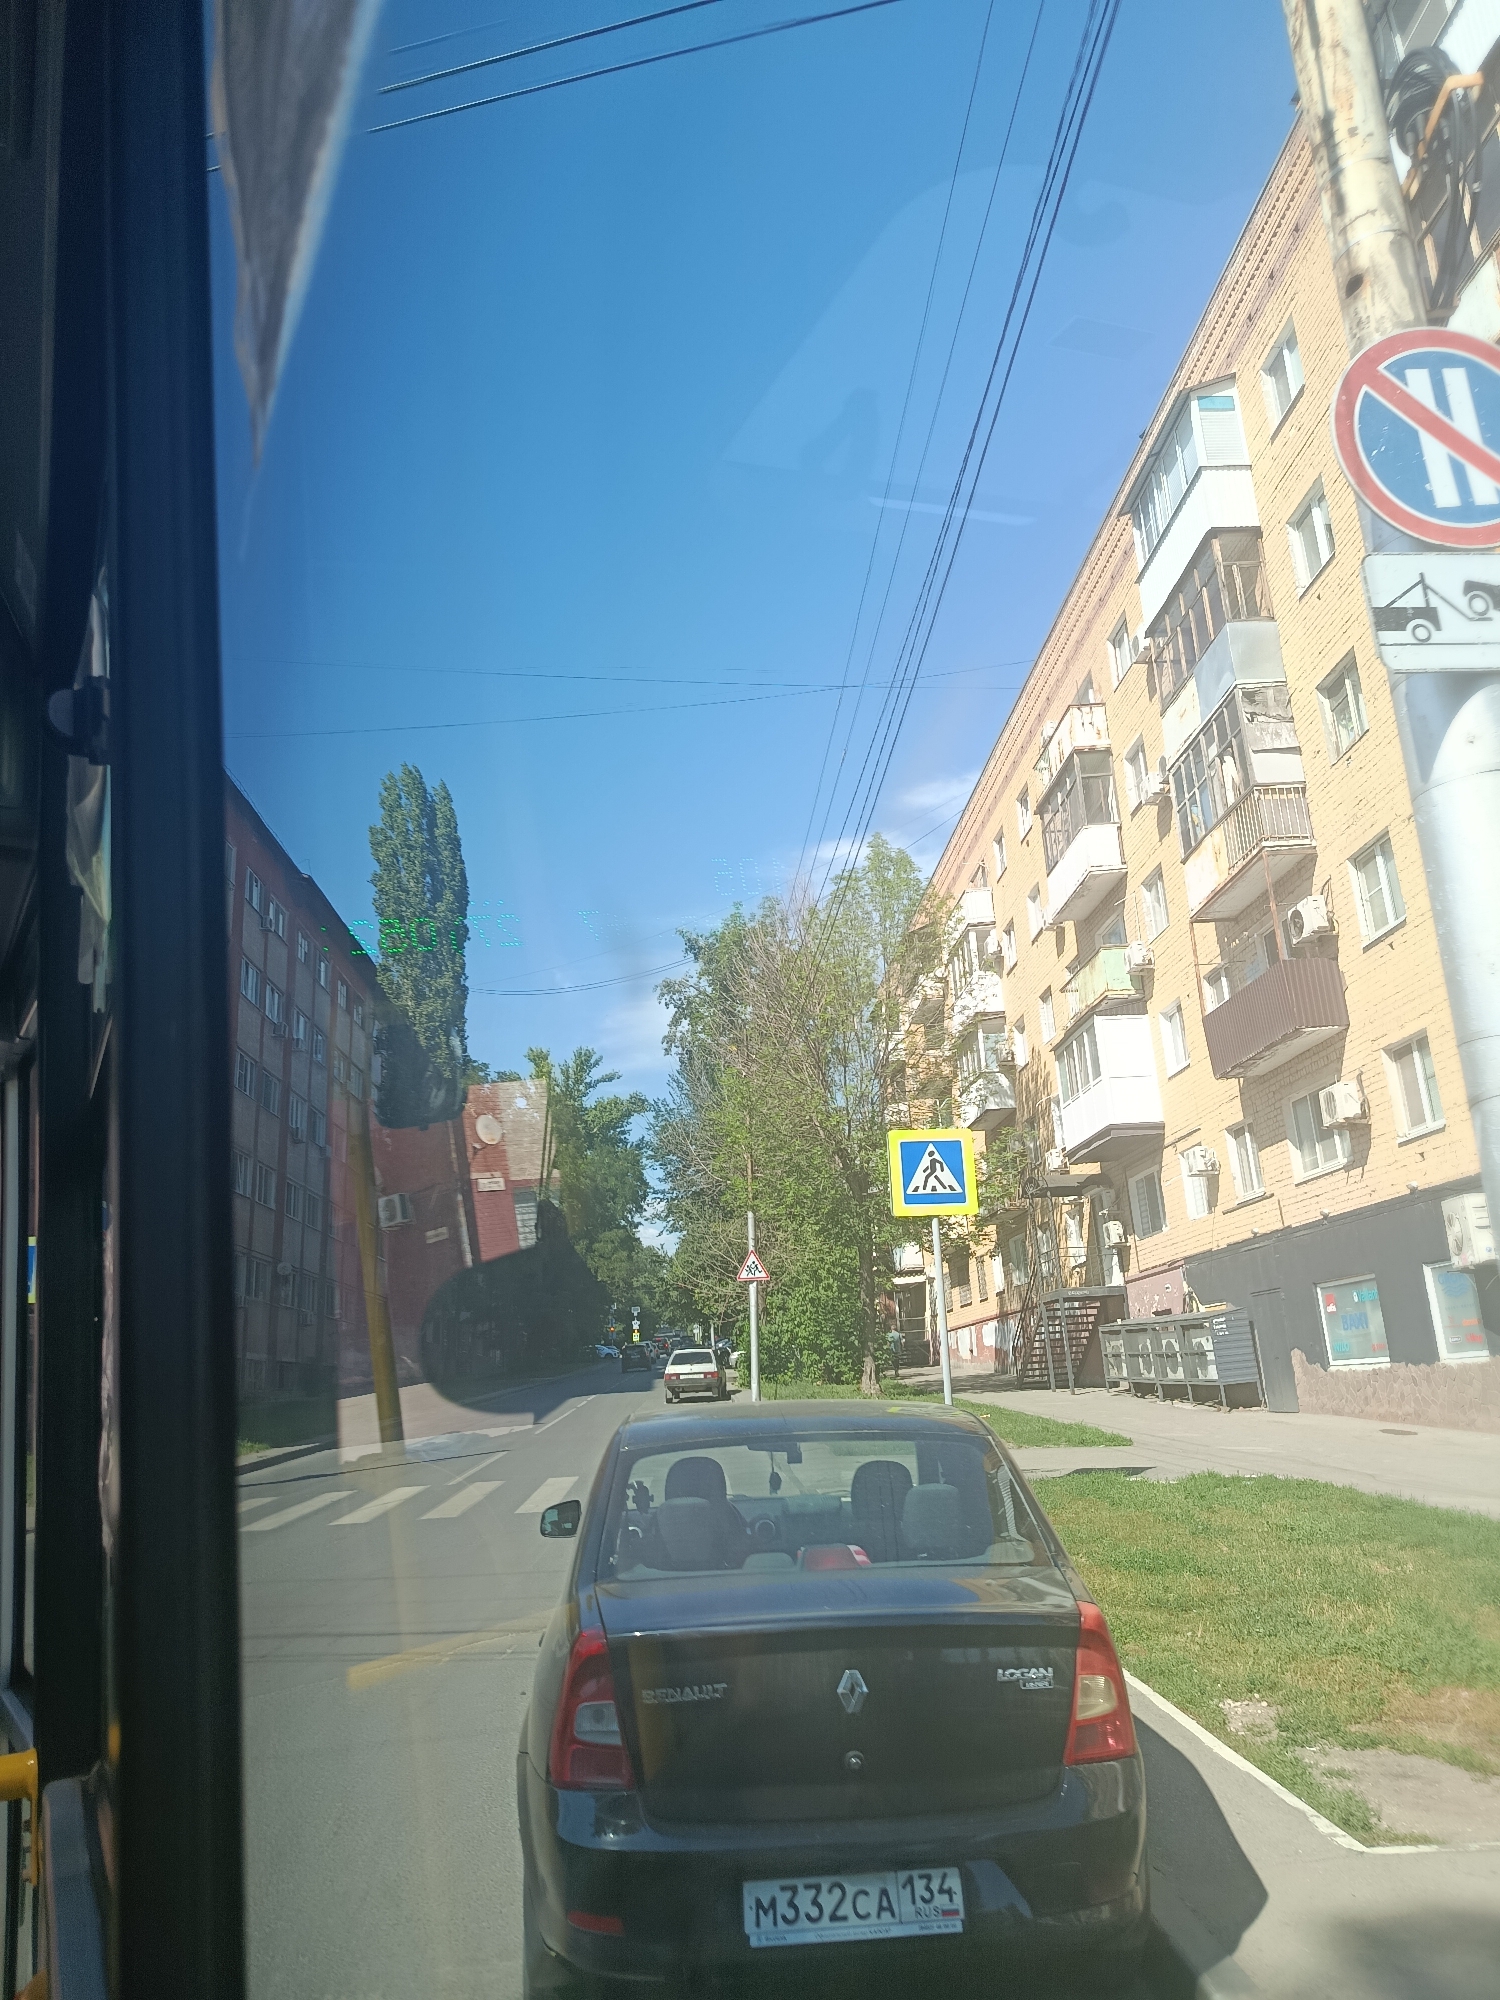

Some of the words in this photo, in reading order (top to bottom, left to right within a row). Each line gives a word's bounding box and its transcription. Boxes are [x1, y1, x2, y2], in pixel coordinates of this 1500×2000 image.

[1341, 1311, 1368, 1331] BAXI
[997, 1667, 1054, 1682] LOGAN
[642, 1683, 727, 1704] RENAULT
[901, 1871, 955, 1905] 134
[914, 1904, 941, 1920] RUS
